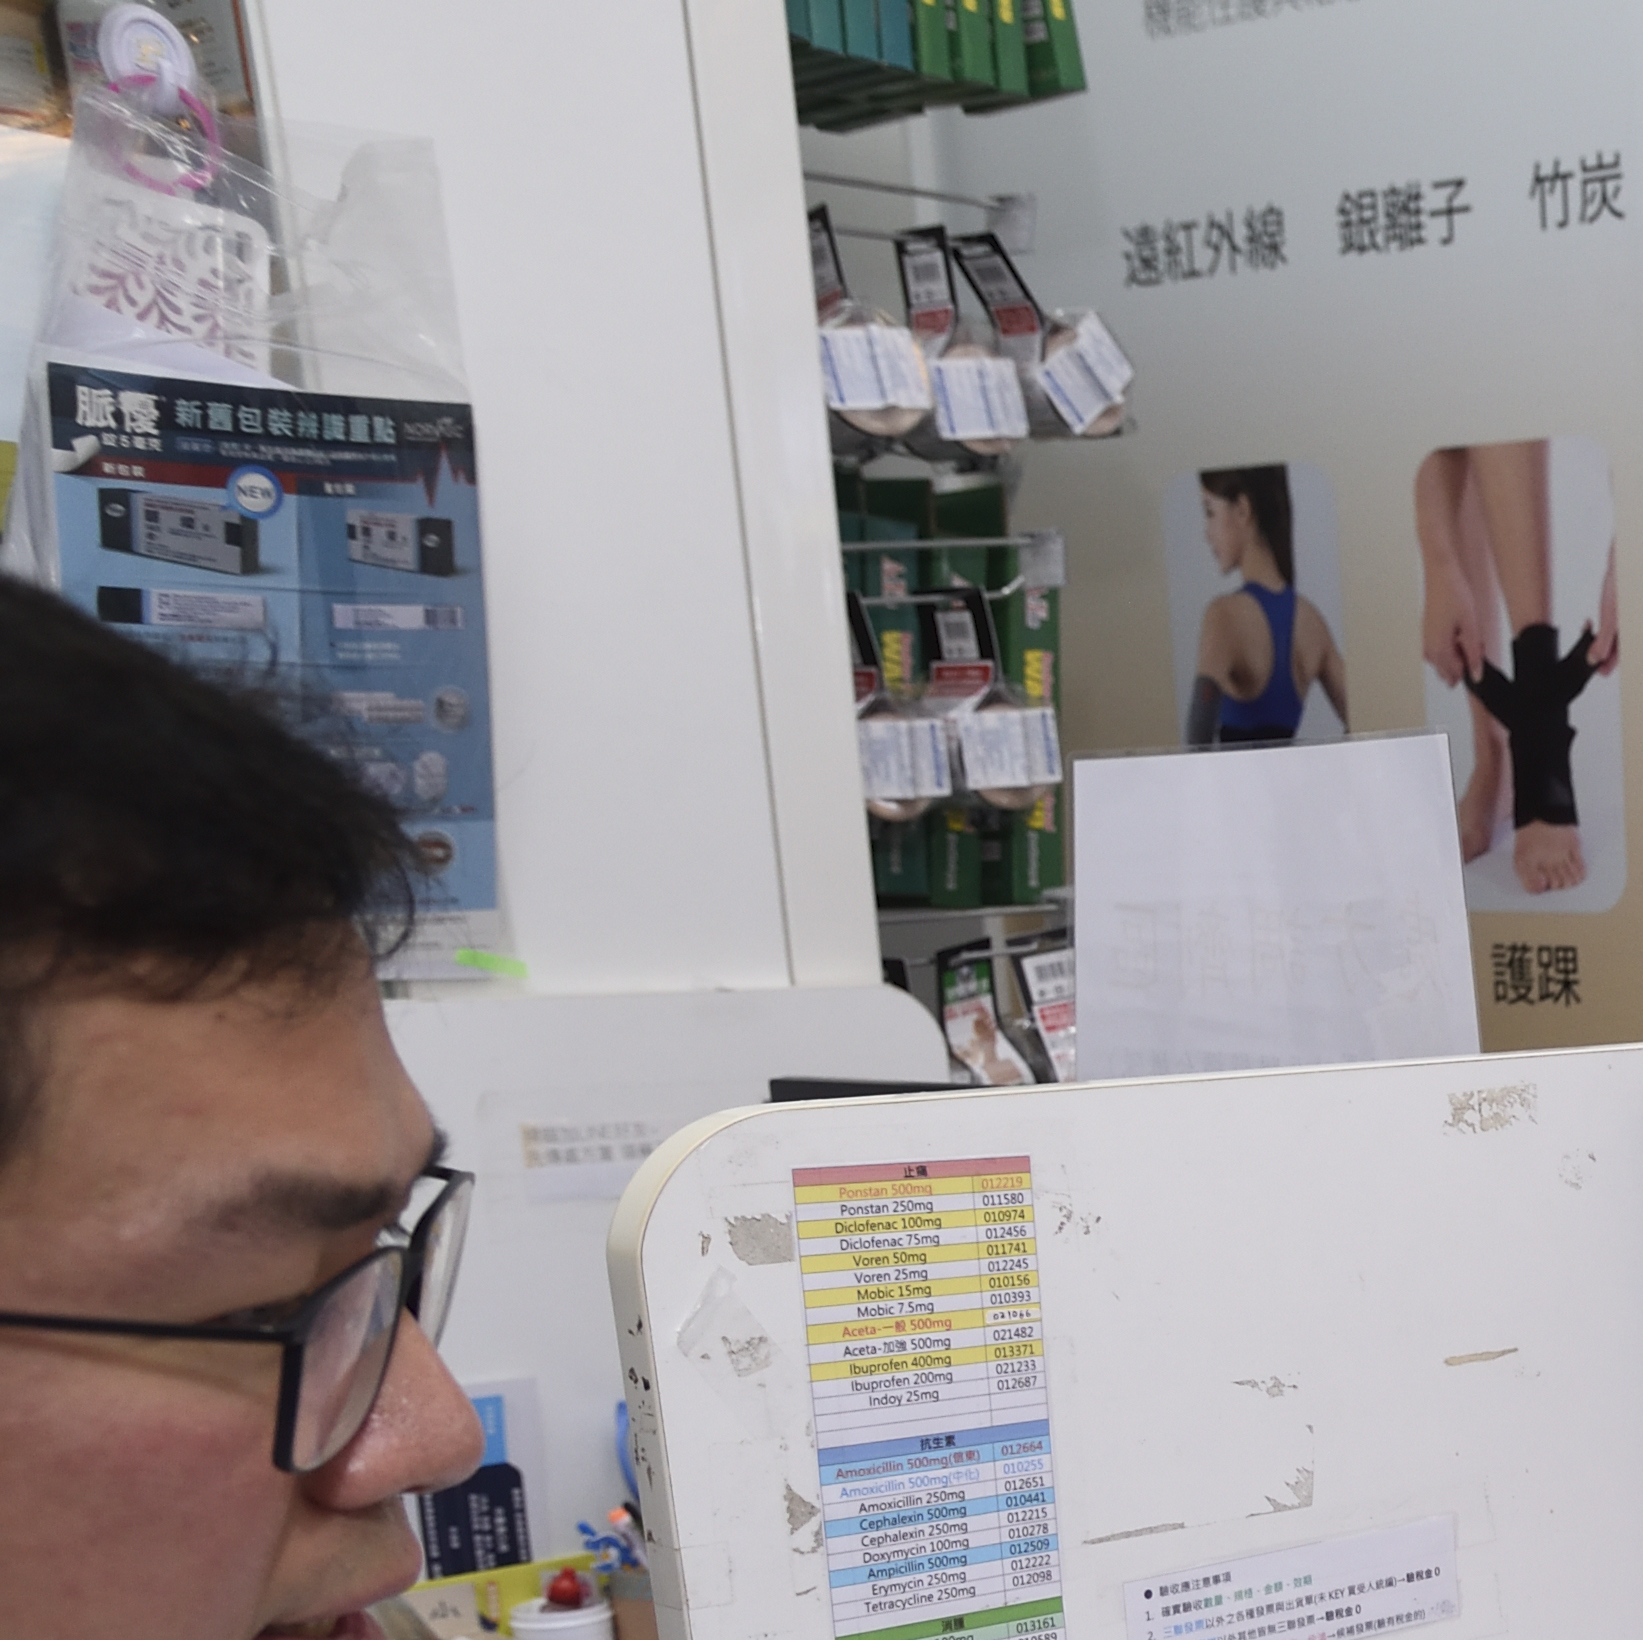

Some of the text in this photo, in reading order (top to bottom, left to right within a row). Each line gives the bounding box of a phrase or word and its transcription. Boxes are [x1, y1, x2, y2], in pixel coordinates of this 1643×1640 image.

[1122, 150, 1625, 289] 遠紅外線 銀離子 竹炭
[236, 483, 275, 500] NEW
[1492, 944, 1581, 1008] 護踝
[839, 1177, 1022, 1198] Ponstan 500mg 012219
[835, 1210, 1025, 1233] Diclofenac 100mg 010974
[853, 1243, 1027, 1267] Voren 50mg 011741
[857, 1291, 1031, 1317] Mobic 7.5mg 010393
[910, 1318, 952, 1332] 500mg
[850, 1344, 1035, 1376] Ibuprofen 400mg 013371
[869, 1377, 1037, 1407] Indoy 25mg 012687
[860, 1492, 1046, 1532] Cephalexin 500mg 010441
[1160, 1572, 1232, 1598] 驗收應注意事項
[1016, 1618, 1056, 1633] 013161
